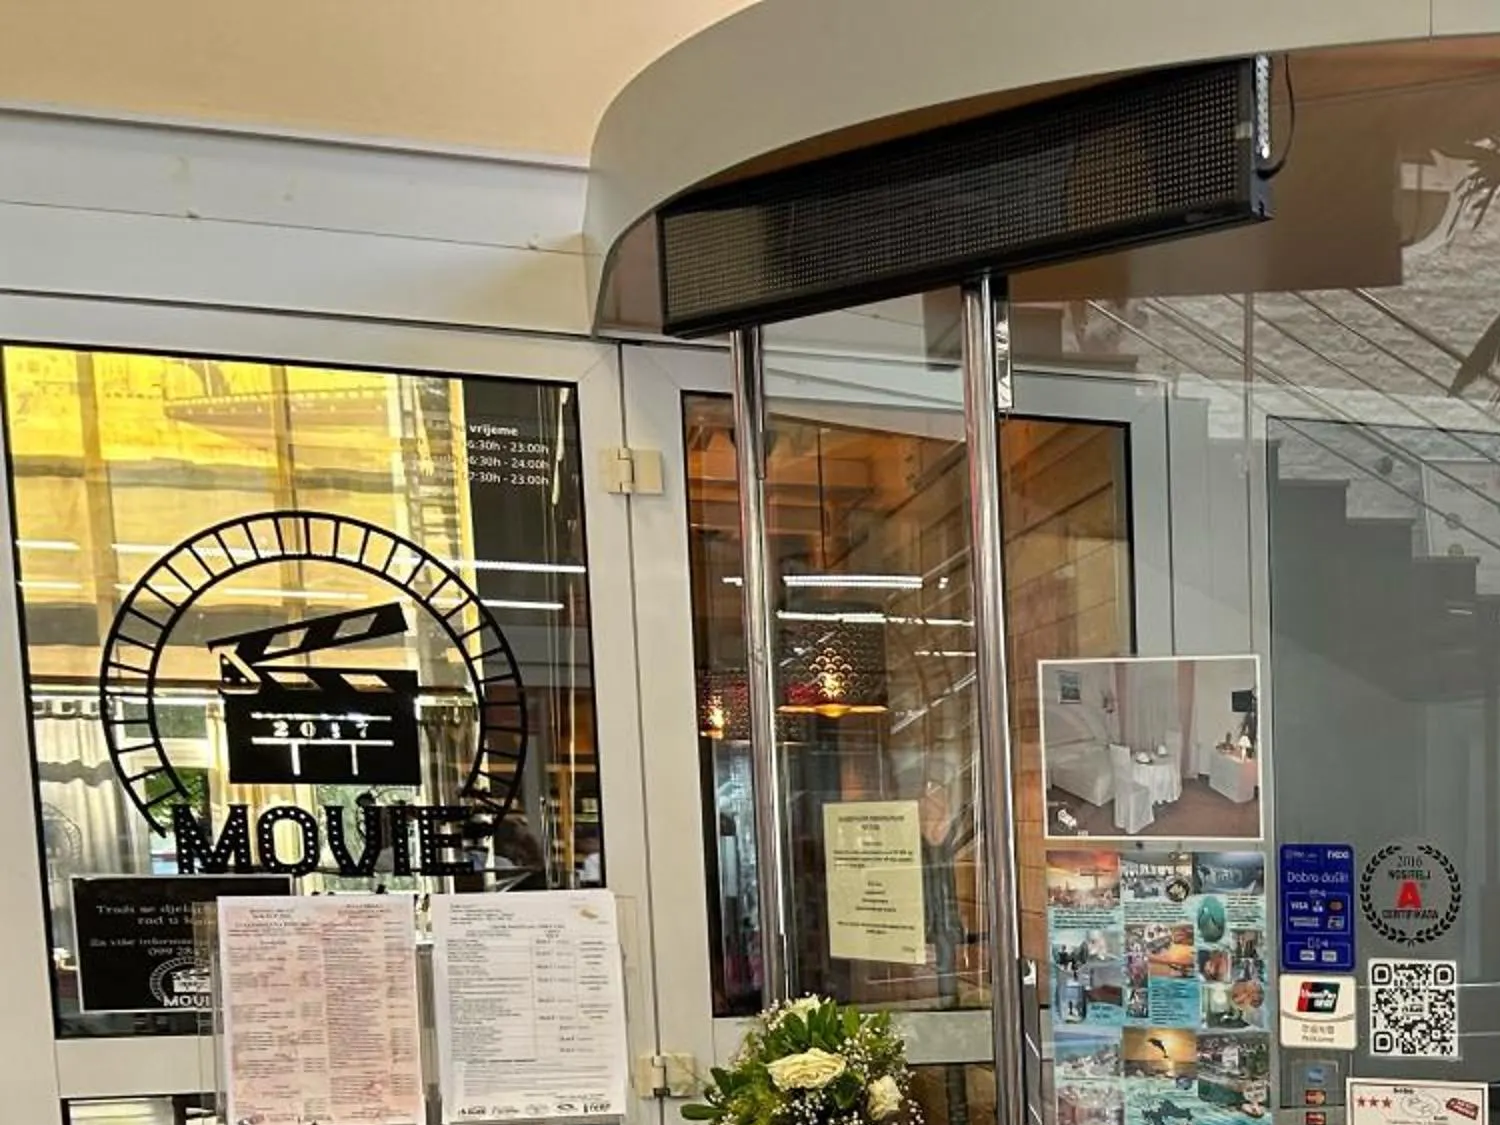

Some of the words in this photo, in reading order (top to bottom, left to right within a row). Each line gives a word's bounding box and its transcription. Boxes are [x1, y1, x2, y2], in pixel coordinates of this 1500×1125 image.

[469, 424, 519, 437] vrijeme
[172, 803, 475, 876] MOVIE
[1286, 870, 1319, 884] Dobro
